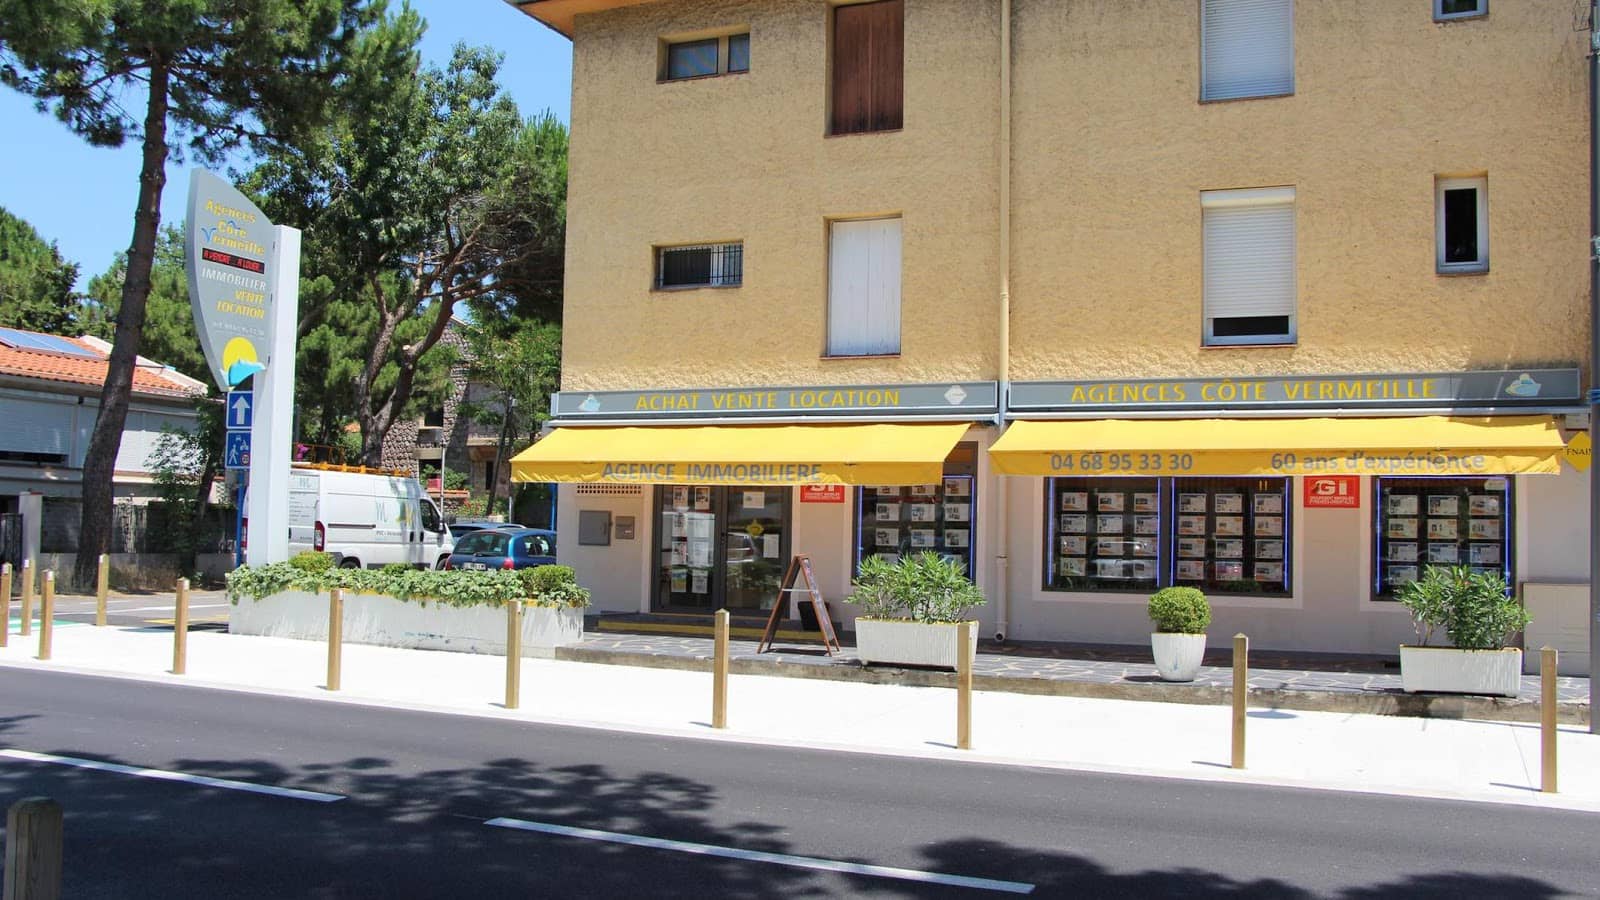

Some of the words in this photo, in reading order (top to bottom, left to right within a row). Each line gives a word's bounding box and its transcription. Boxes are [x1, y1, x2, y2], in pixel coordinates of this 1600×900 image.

[205, 200, 256, 224] Agences
[200, 227, 265, 255] Vermeille
[201, 267, 266, 290] IMMOBILIER
[235, 289, 265, 304] VENTE
[216, 300, 265, 319] LOCATION
[635, 393, 699, 411] ACHAT
[711, 391, 777, 409] VENTE
[789, 388, 899, 408] LOCATION
[1071, 383, 1186, 403] AGENCES
[1201, 378, 1267, 401] CÔTE
[1051, 453, 1074, 470] 04
[1080, 453, 1102, 470] 68
[1109, 453, 1132, 470] 95
[1138, 453, 1162, 470] 33
[1168, 453, 1193, 470] 30
[1271, 453, 1296, 470] 60
[1303, 455, 1338, 470] ans
[602, 463, 676, 481] AGENCE
[687, 464, 822, 482] IMMOBILIERE
